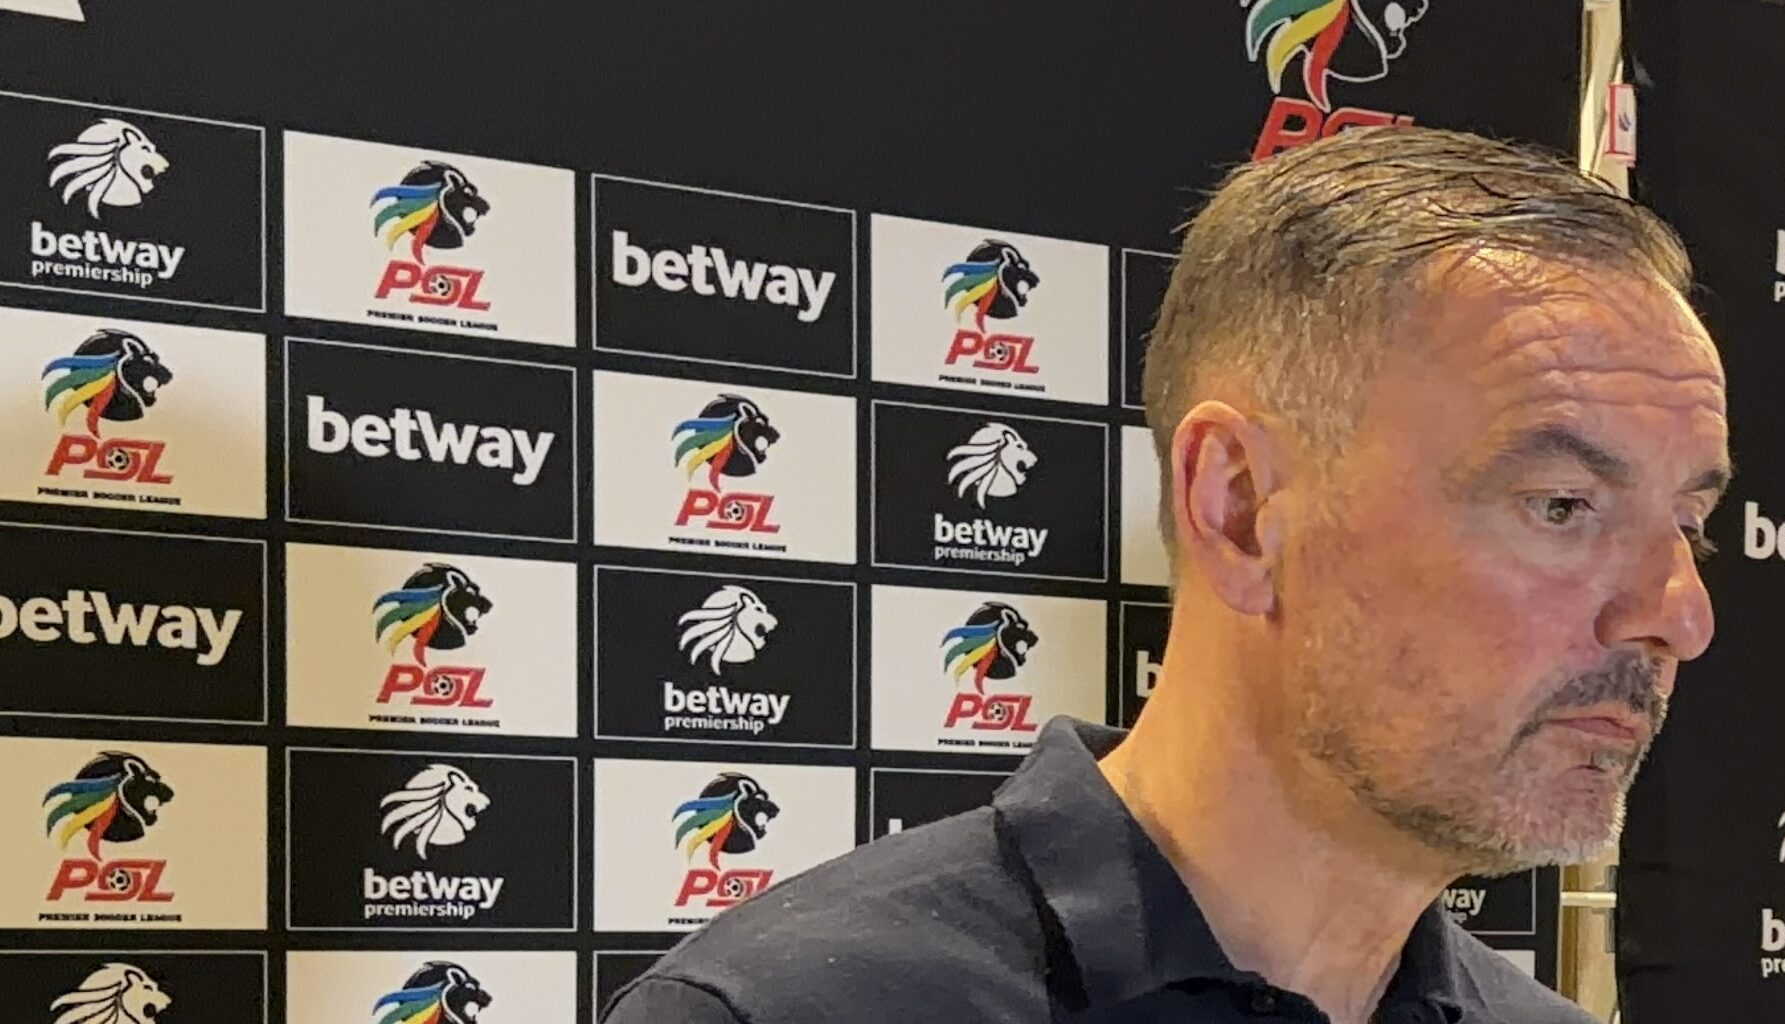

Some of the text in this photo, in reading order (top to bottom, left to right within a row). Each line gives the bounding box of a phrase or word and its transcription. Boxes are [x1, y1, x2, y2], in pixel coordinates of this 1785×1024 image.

[30, 221, 185, 279] betway
[31, 258, 152, 288] premiership
[374, 258, 491, 311] PSL
[611, 230, 836, 322] betway
[945, 329, 1039, 375] PSL
[45, 434, 174, 485] PSL
[307, 395, 555, 486] betway
[674, 489, 780, 534] PSL
[934, 513, 1048, 557] betway
[934, 542, 1025, 566] premiership
[376, 664, 493, 708] PSL
[664, 682, 790, 725] betway
[664, 714, 764, 735] premiership
[944, 693, 1037, 732] PSL
[47, 858, 175, 902] PSL
[364, 868, 503, 909] betway
[364, 900, 475, 920] premiership
